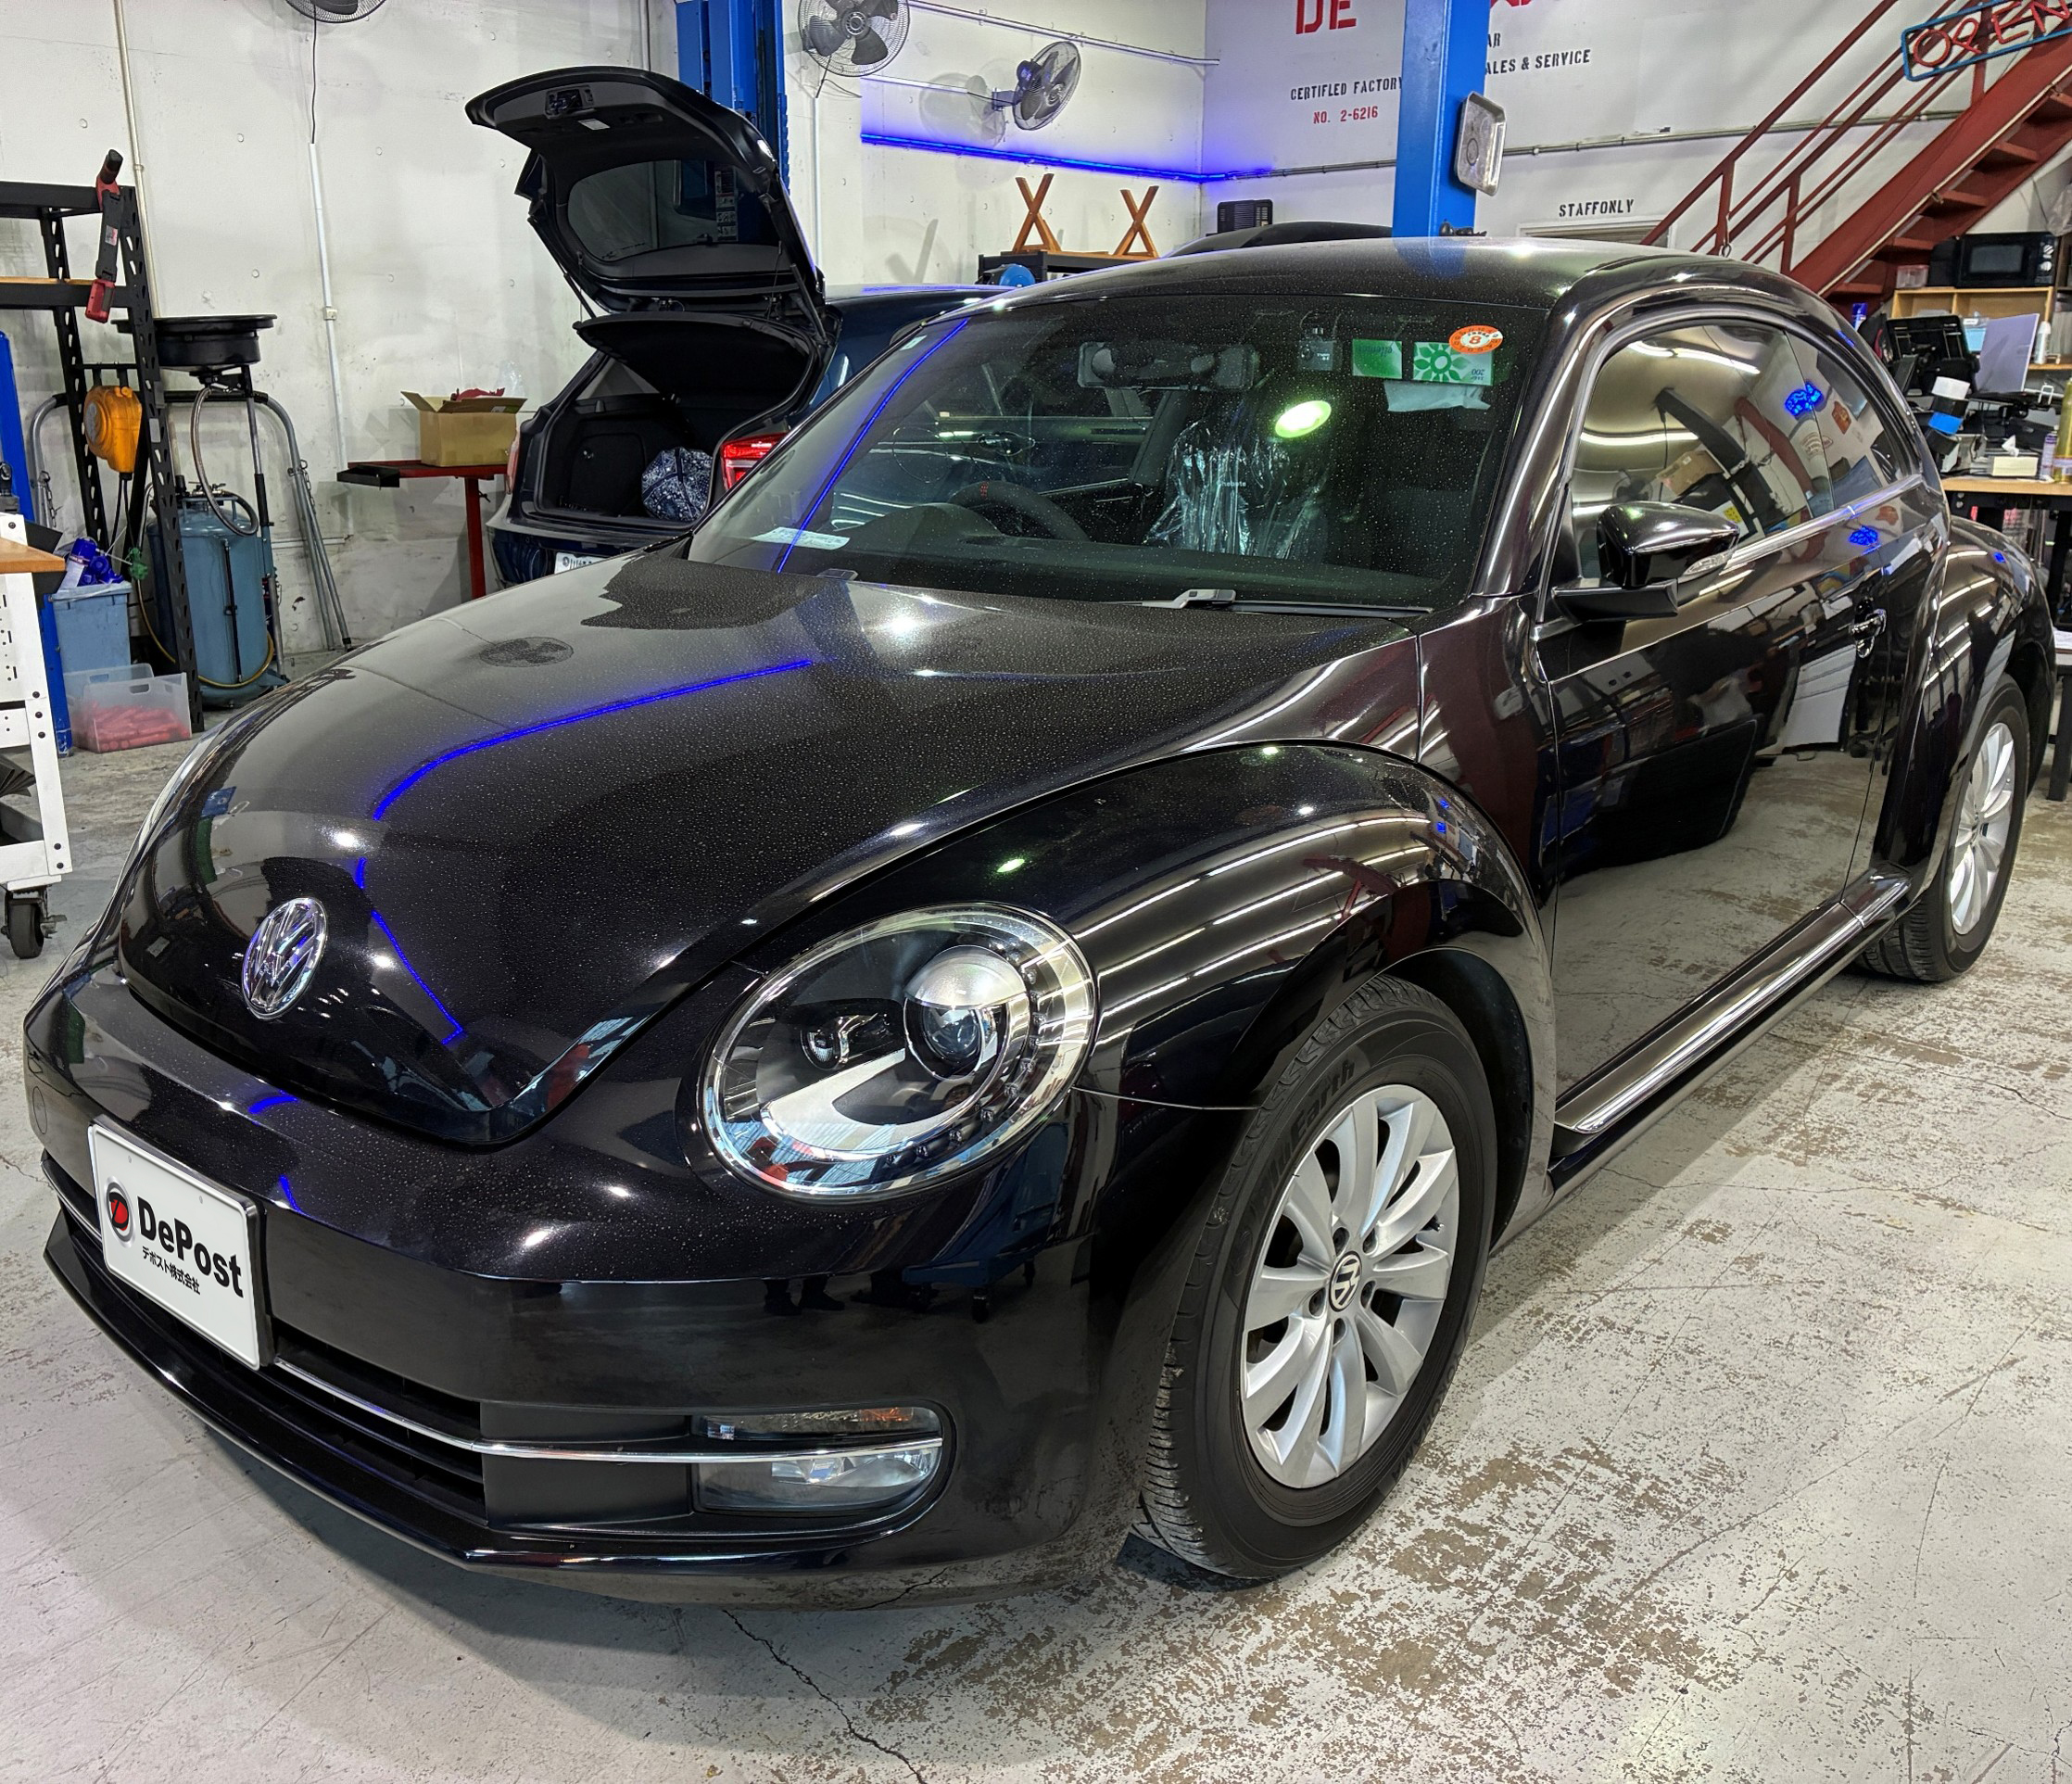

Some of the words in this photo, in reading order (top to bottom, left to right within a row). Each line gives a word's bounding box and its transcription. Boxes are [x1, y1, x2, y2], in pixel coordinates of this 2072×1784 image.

[1295, 0, 1358, 34] DE
[1913, 0, 2069, 67] OPEN
[1521, 57, 1529, 70] &
[1535, 49, 1591, 70] SERVICE
[1313, 111, 1331, 124] NO.
[1340, 106, 1378, 122] 2-6216
[1469, 335, 1482, 345] 8
[136, 1196, 245, 1299] DePost
